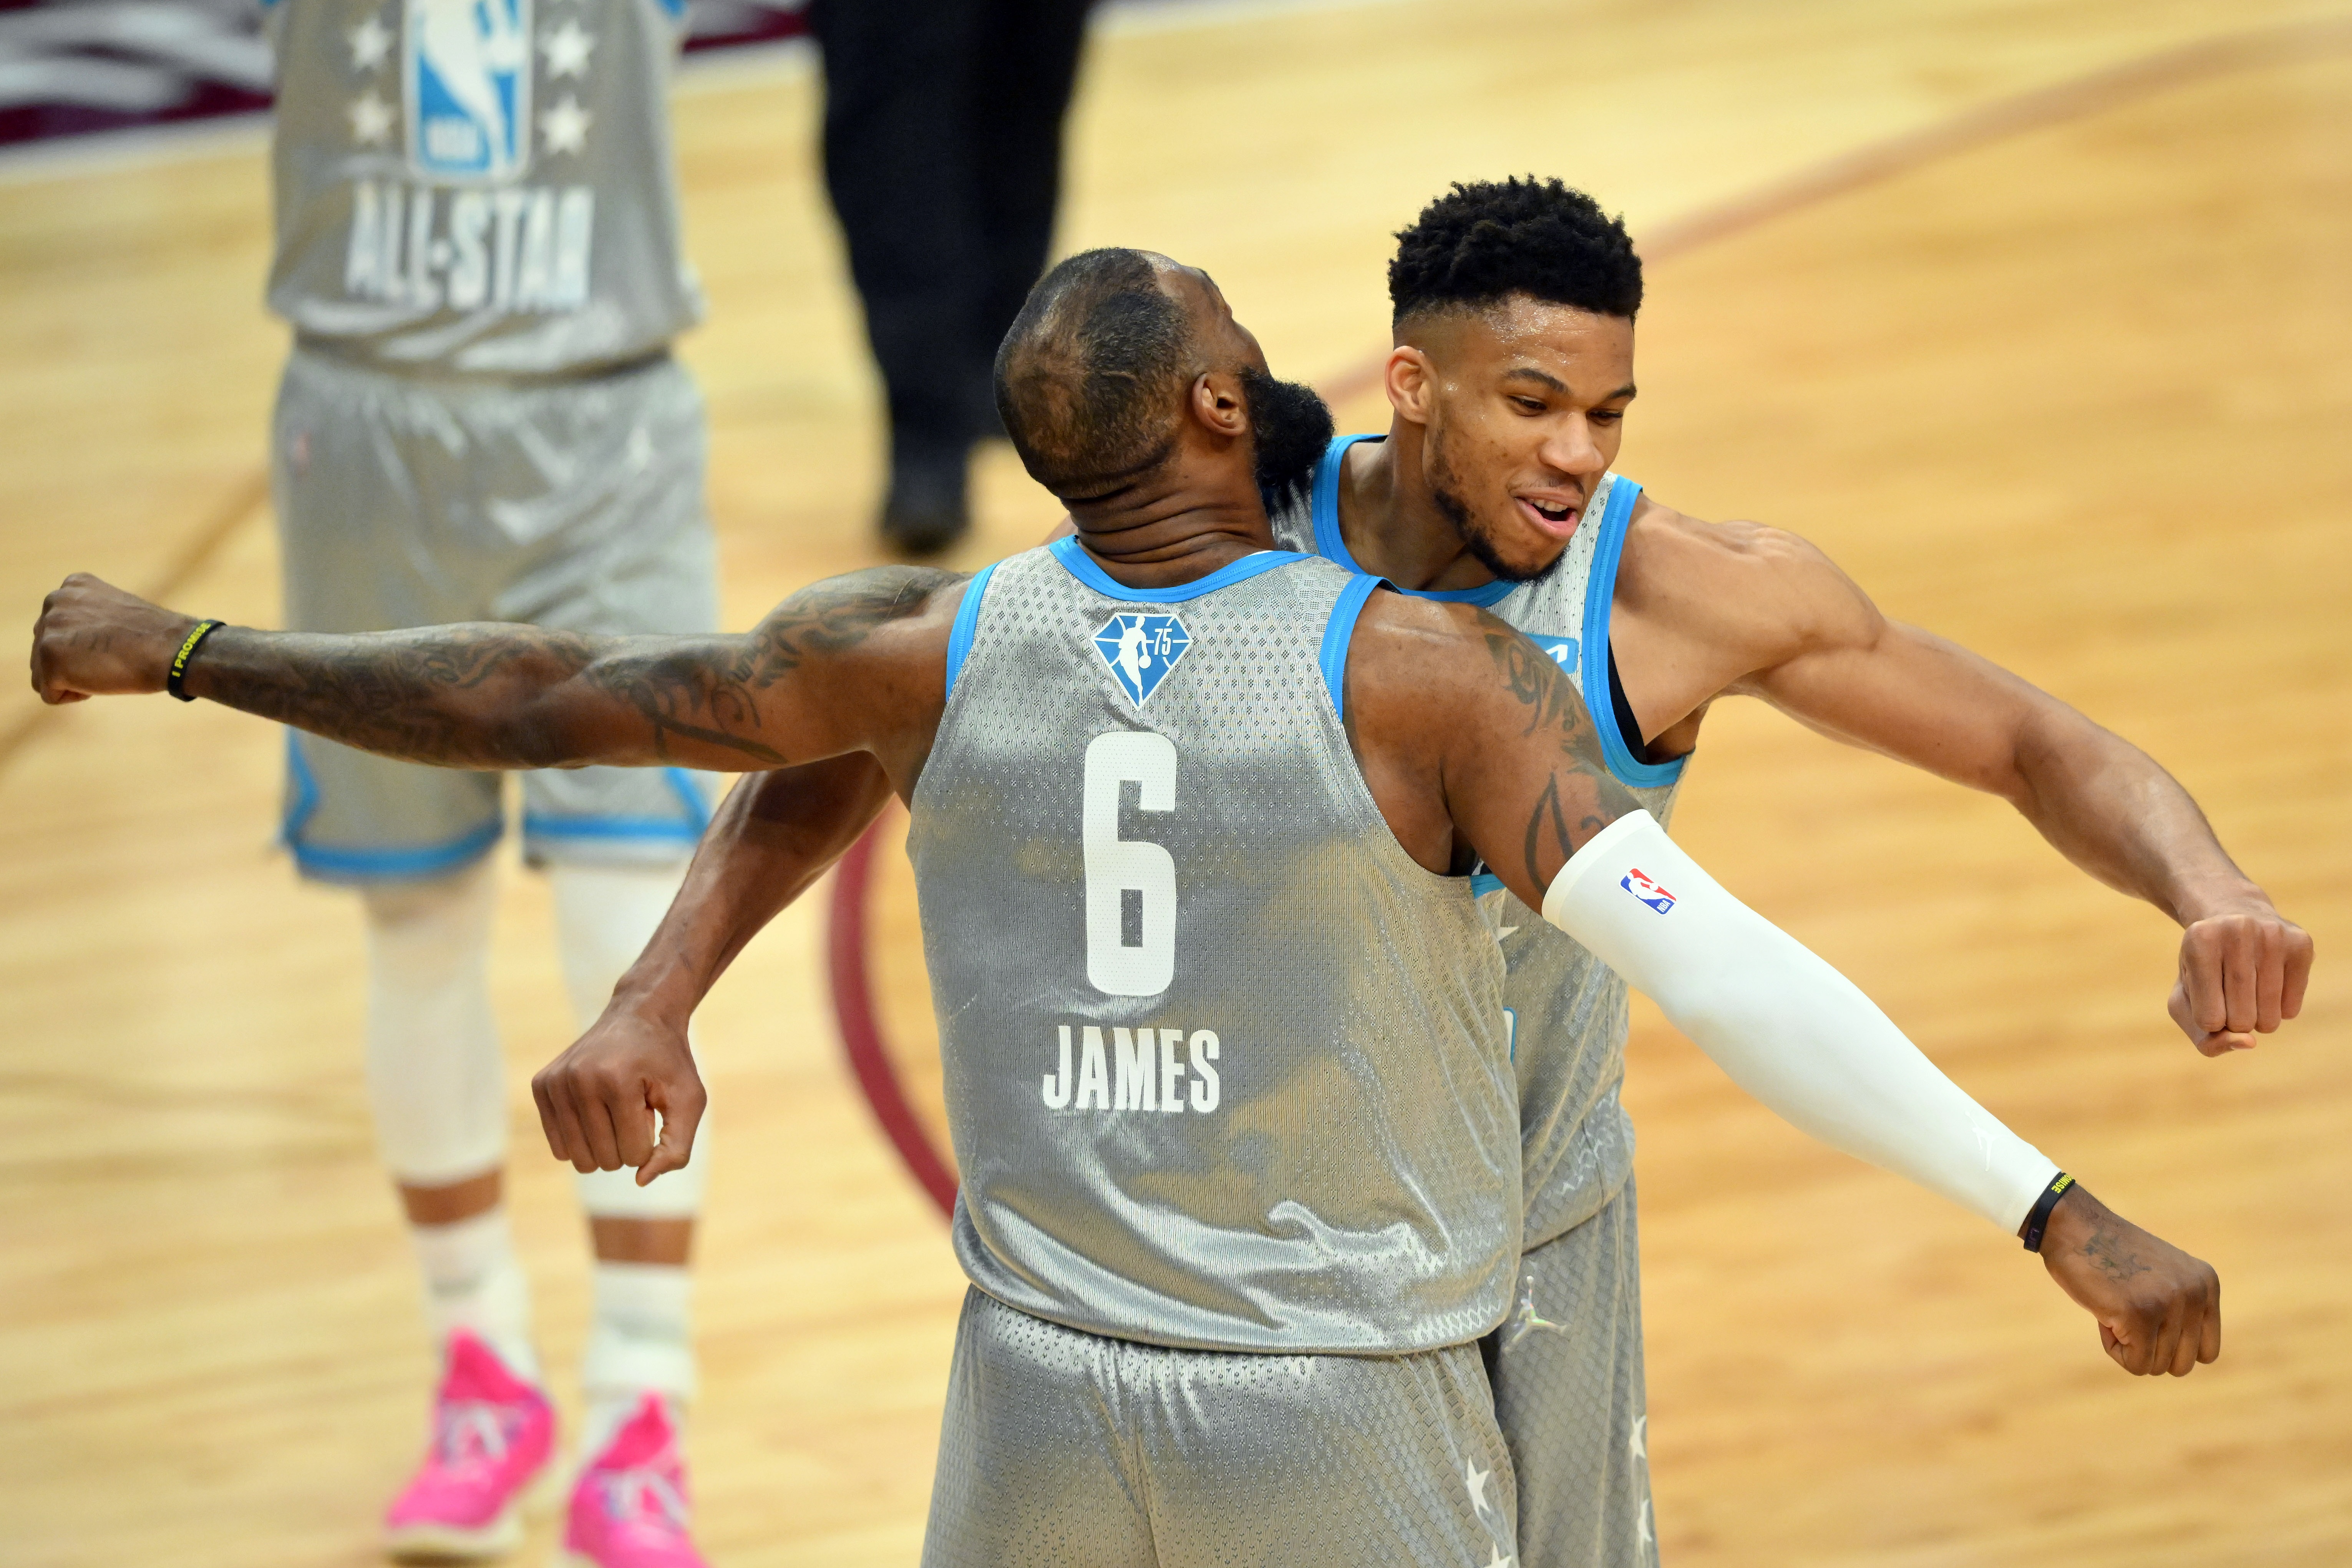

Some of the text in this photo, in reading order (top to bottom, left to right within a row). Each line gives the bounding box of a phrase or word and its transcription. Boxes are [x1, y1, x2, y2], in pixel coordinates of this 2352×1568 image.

[174, 622, 211, 669] PROMISE
[1154, 628, 1173, 655] 75
[1083, 732, 1177, 996] 6
[1657, 899, 1670, 913] NBA
[1043, 1025, 1219, 1113] JAMES
